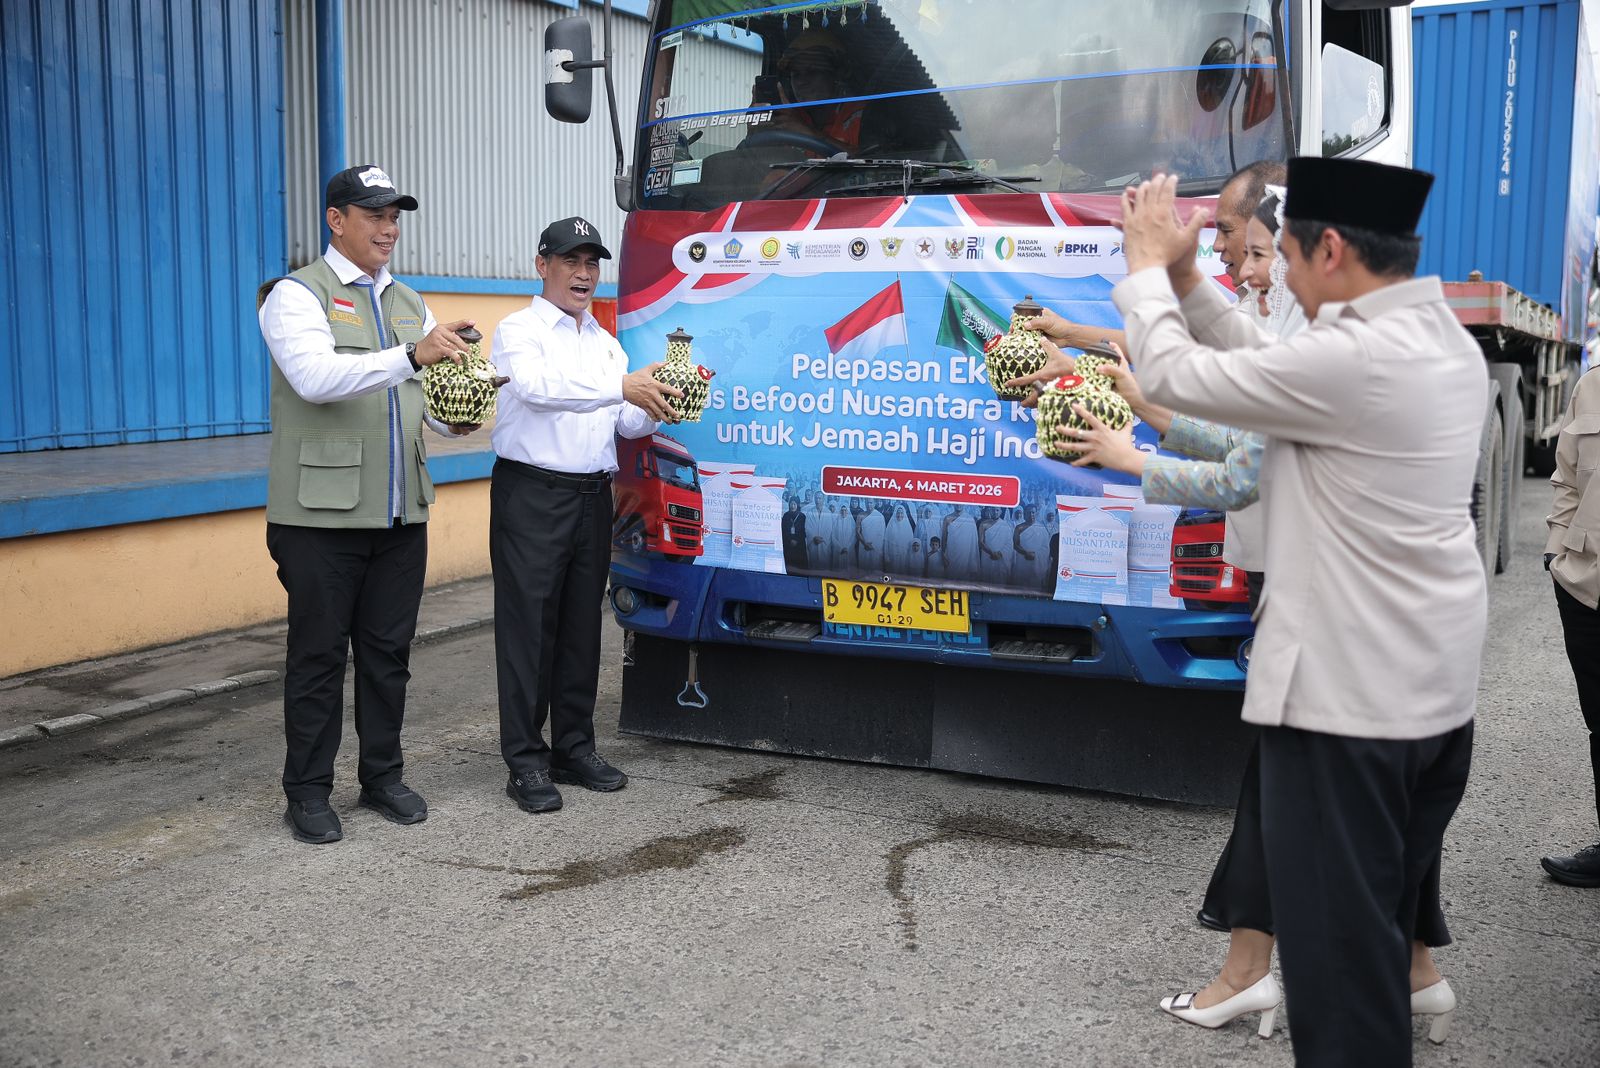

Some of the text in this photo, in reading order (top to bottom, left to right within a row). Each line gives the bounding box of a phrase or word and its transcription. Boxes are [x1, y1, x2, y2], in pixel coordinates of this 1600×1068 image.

[680, 110, 773, 131] Slow Bergengsi
[1065, 243, 1098, 254] BPKH
[792, 353, 987, 387] Pelepasan Ek
[733, 385, 834, 414] Befood
[842, 388, 1002, 422] Nusantara
[717, 420, 794, 446] untuk
[801, 421, 919, 453] Jemaah
[927, 426, 986, 465] Haji
[836, 475, 1002, 496] JAKARTA, 4 MARET 2026
[1128, 521, 1164, 530] efood
[825, 582, 965, 616] B 9947 SEH
